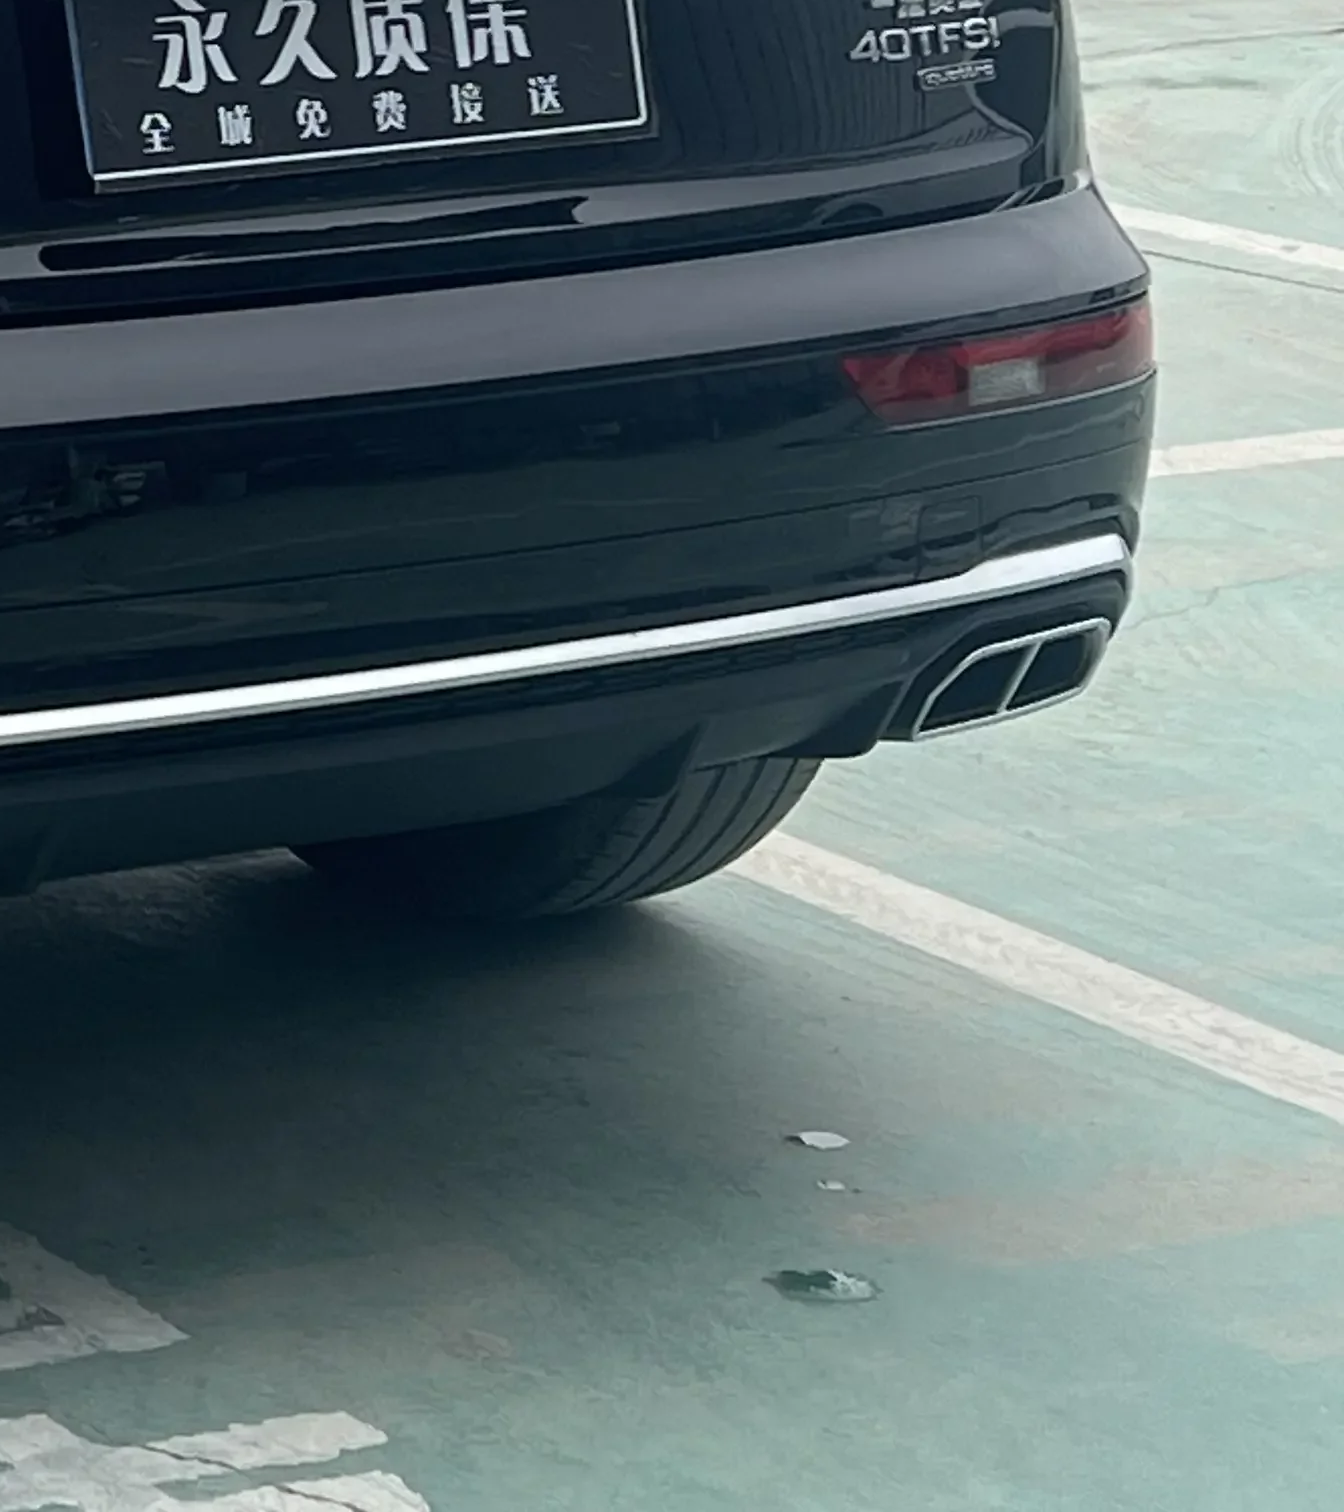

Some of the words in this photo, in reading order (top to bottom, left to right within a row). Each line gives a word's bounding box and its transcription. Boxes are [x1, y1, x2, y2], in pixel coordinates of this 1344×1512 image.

[139, 73, 564, 155] 全城免费接送
